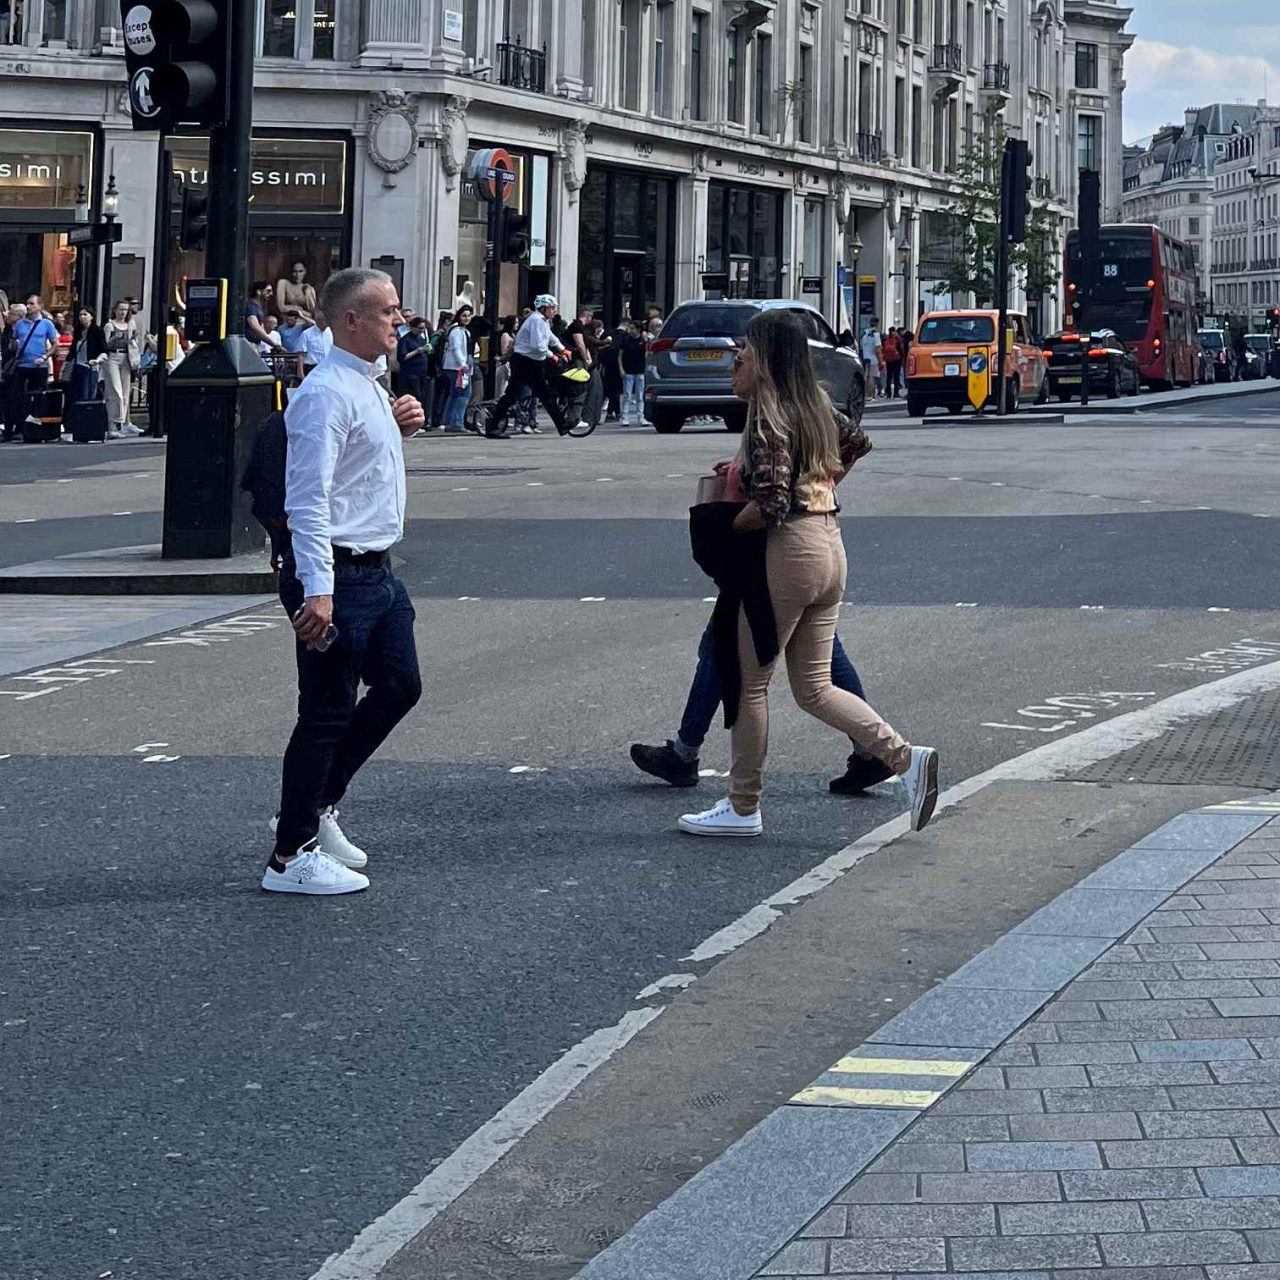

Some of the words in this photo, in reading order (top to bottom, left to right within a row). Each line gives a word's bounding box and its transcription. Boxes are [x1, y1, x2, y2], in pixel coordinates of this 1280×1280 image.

[125, 22, 148, 34] Excep
[0, 163, 60, 179] simi
[1103, 264, 1118, 277] 88
[980, 691, 1156, 733] LOOK
